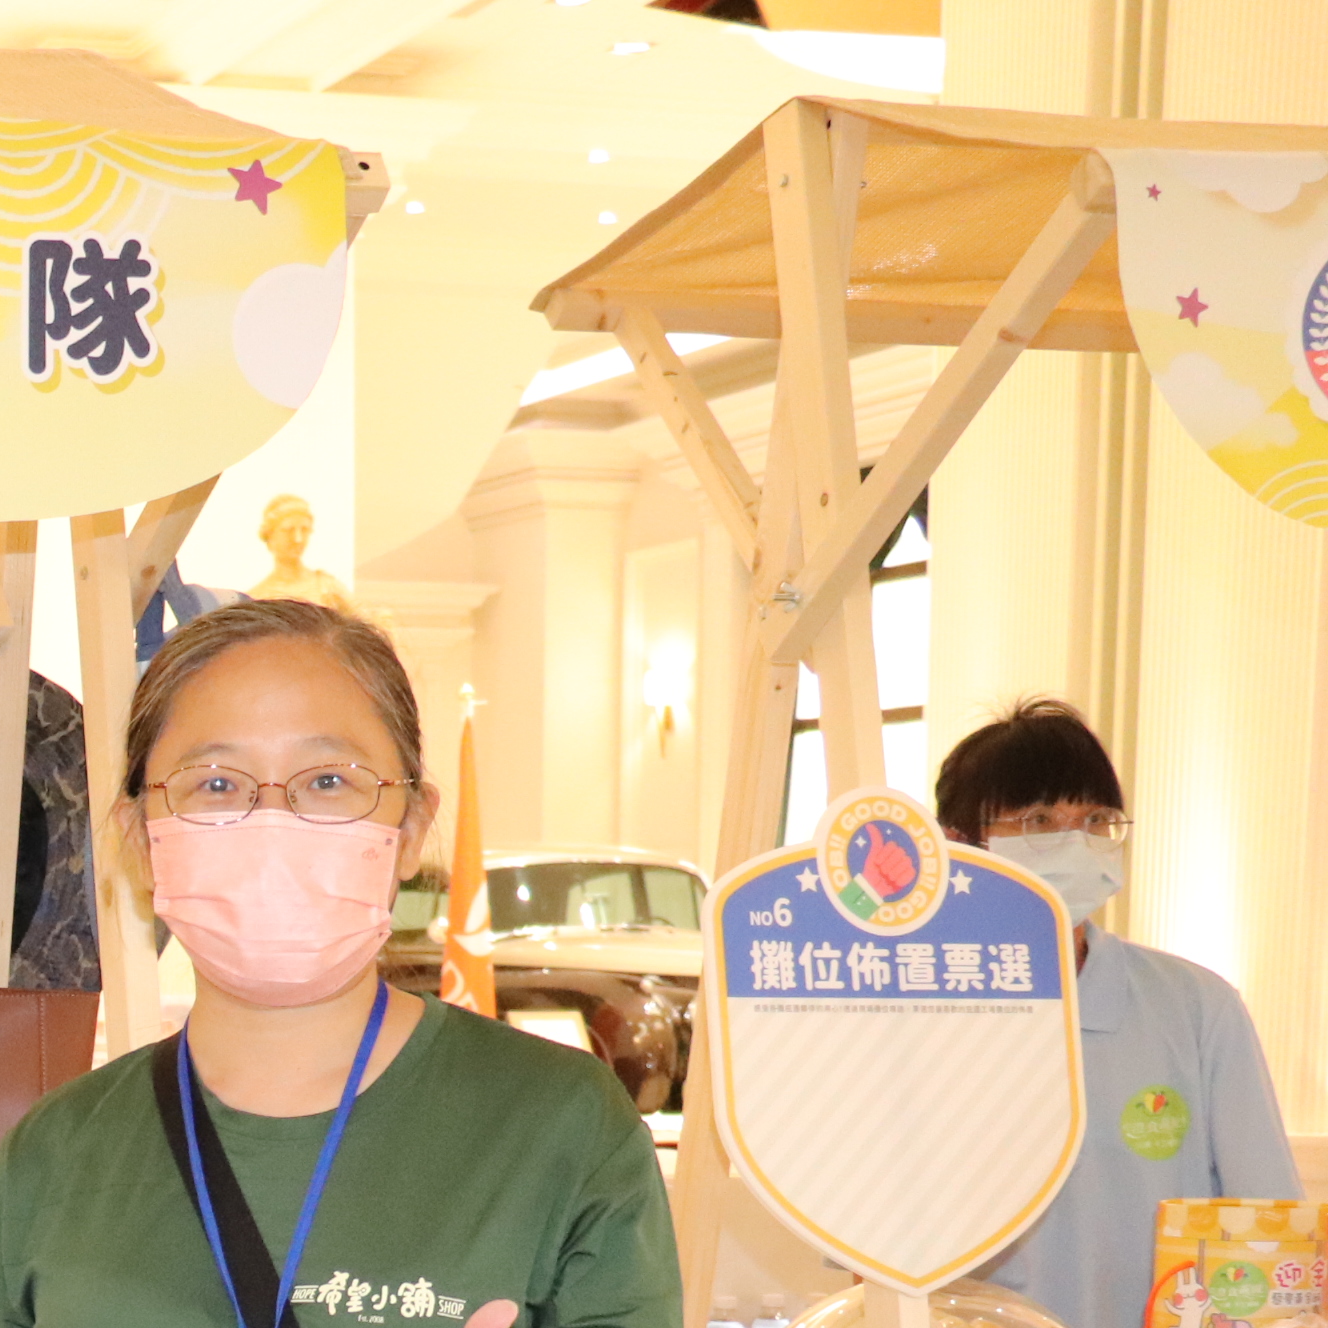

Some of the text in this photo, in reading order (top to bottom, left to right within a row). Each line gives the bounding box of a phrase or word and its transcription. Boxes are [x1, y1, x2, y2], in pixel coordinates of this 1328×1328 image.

[841, 800, 907, 831] GOOD
[749, 940, 1034, 992] 攤位佈置票選
[292, 1288, 317, 1301] HOPE
[438, 1300, 465, 1317] SHOP
